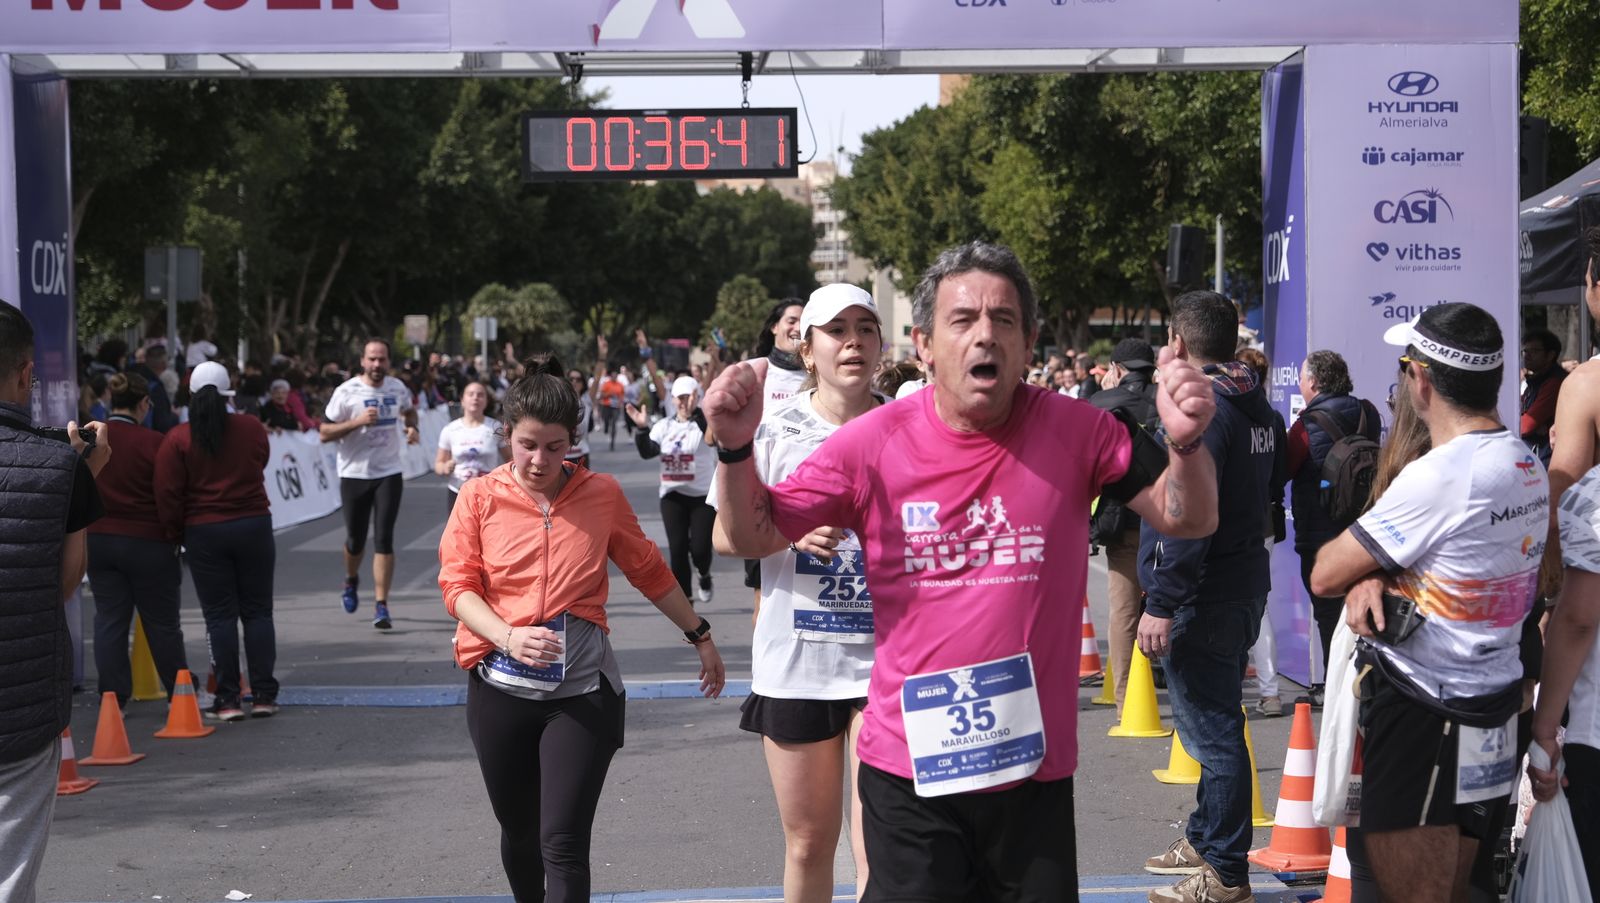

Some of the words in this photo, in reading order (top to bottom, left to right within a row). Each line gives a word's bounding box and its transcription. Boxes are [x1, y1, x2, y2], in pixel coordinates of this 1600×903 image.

[1368, 101, 1459, 113] HYUNDAI
[1379, 116, 1448, 128] Almerialva
[1390, 147, 1465, 167] cajamar
[1373, 199, 1437, 224] CASI
[1266, 214, 1294, 285] CDX
[1395, 242, 1462, 261] vithas
[31, 232, 67, 296] CDX
[1412, 264, 1429, 273] para
[1430, 263, 1462, 272] cuidarte
[1272, 361, 1301, 387] ALMERÍA
[1250, 426, 1275, 454] NEXA
[907, 505, 937, 527] IX
[1018, 525, 1031, 534] de
[1032, 524, 1043, 532] la
[904, 535, 1046, 573] MUJER
[919, 579, 964, 588] IGUALDAD
[965, 578, 977, 587] ES
[978, 576, 1016, 586] NUESTRA
[1016, 574, 1040, 583] META
[916, 687, 948, 699] MUJER
[946, 699, 997, 737] 35
[941, 727, 1012, 749] MARAVILLOSO
